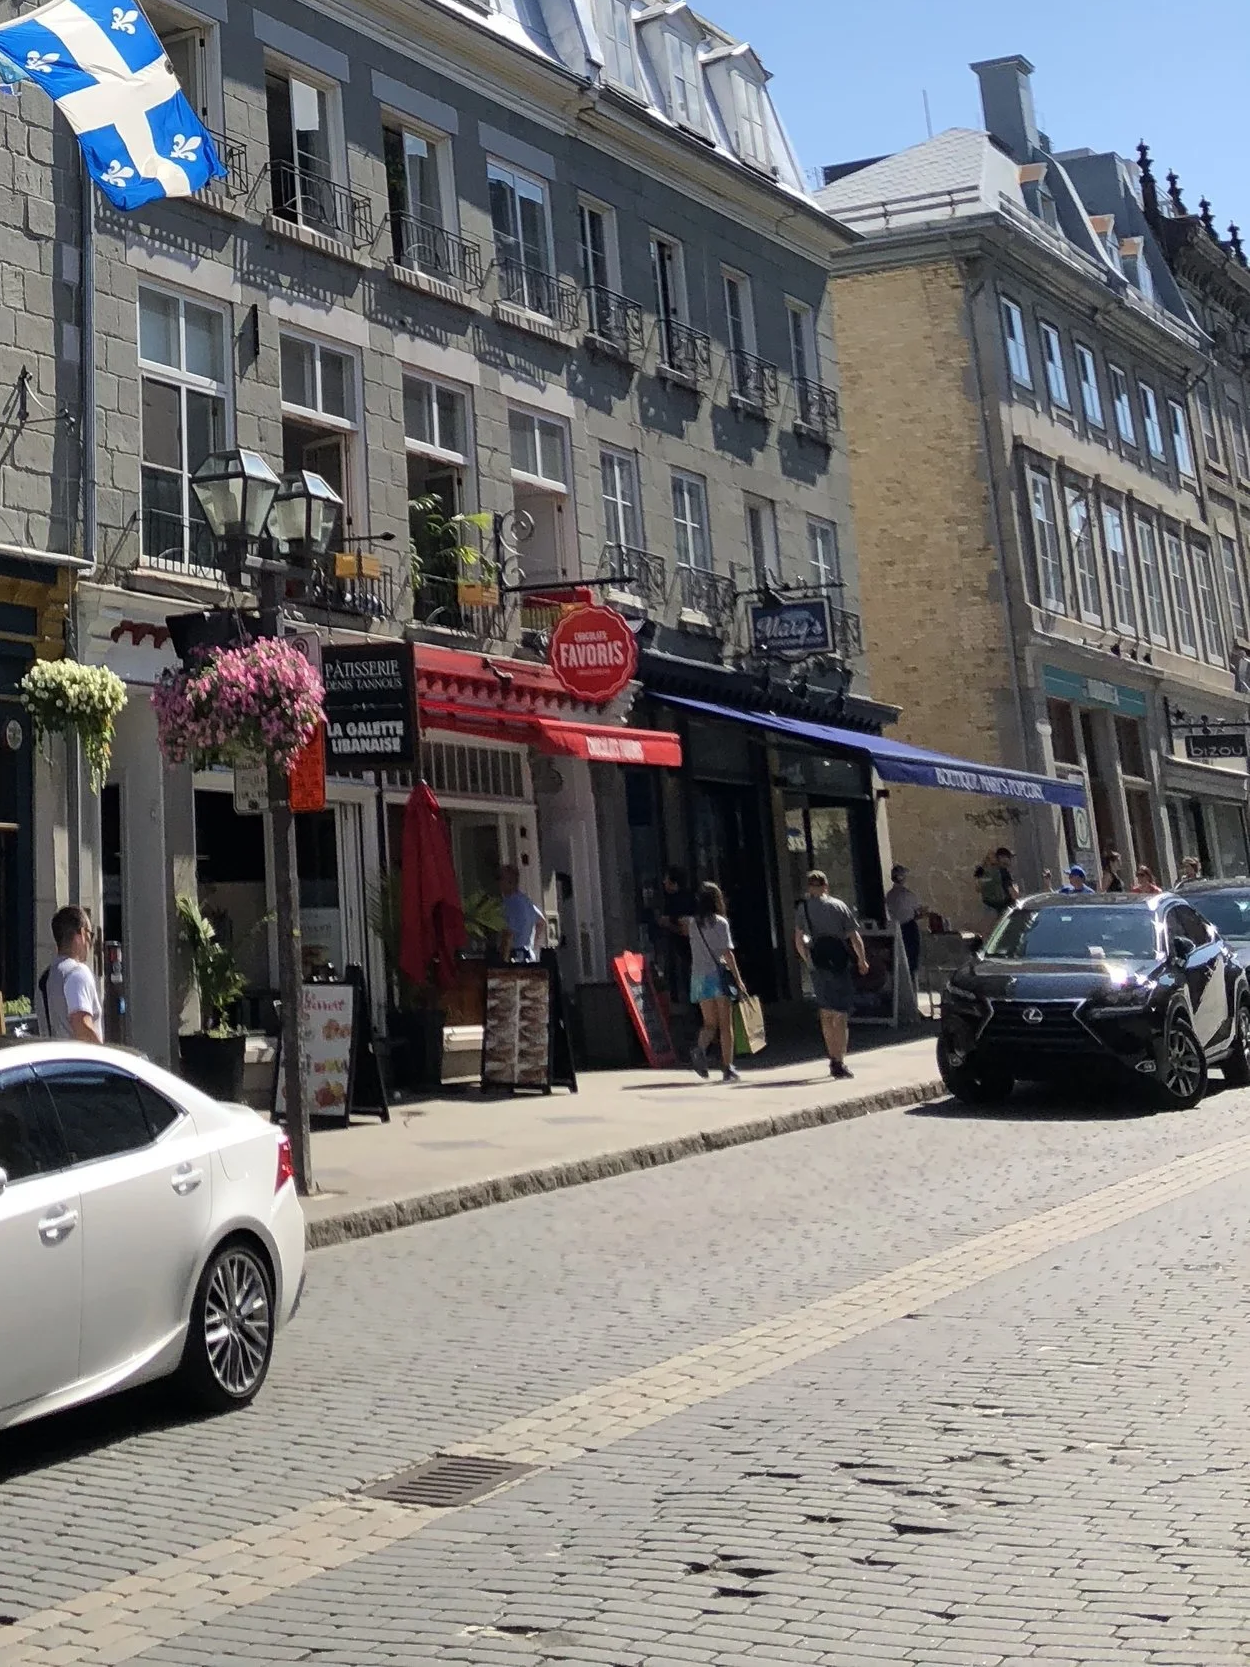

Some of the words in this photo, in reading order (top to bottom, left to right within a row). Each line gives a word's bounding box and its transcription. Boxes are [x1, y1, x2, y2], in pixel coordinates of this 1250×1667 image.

[559, 640, 625, 669] FAVORIS
[327, 723, 343, 737] LA
[345, 720, 404, 737] GALETTE
[331, 736, 401, 754] LIBANAISE
[1190, 738, 1243, 757] bizou
